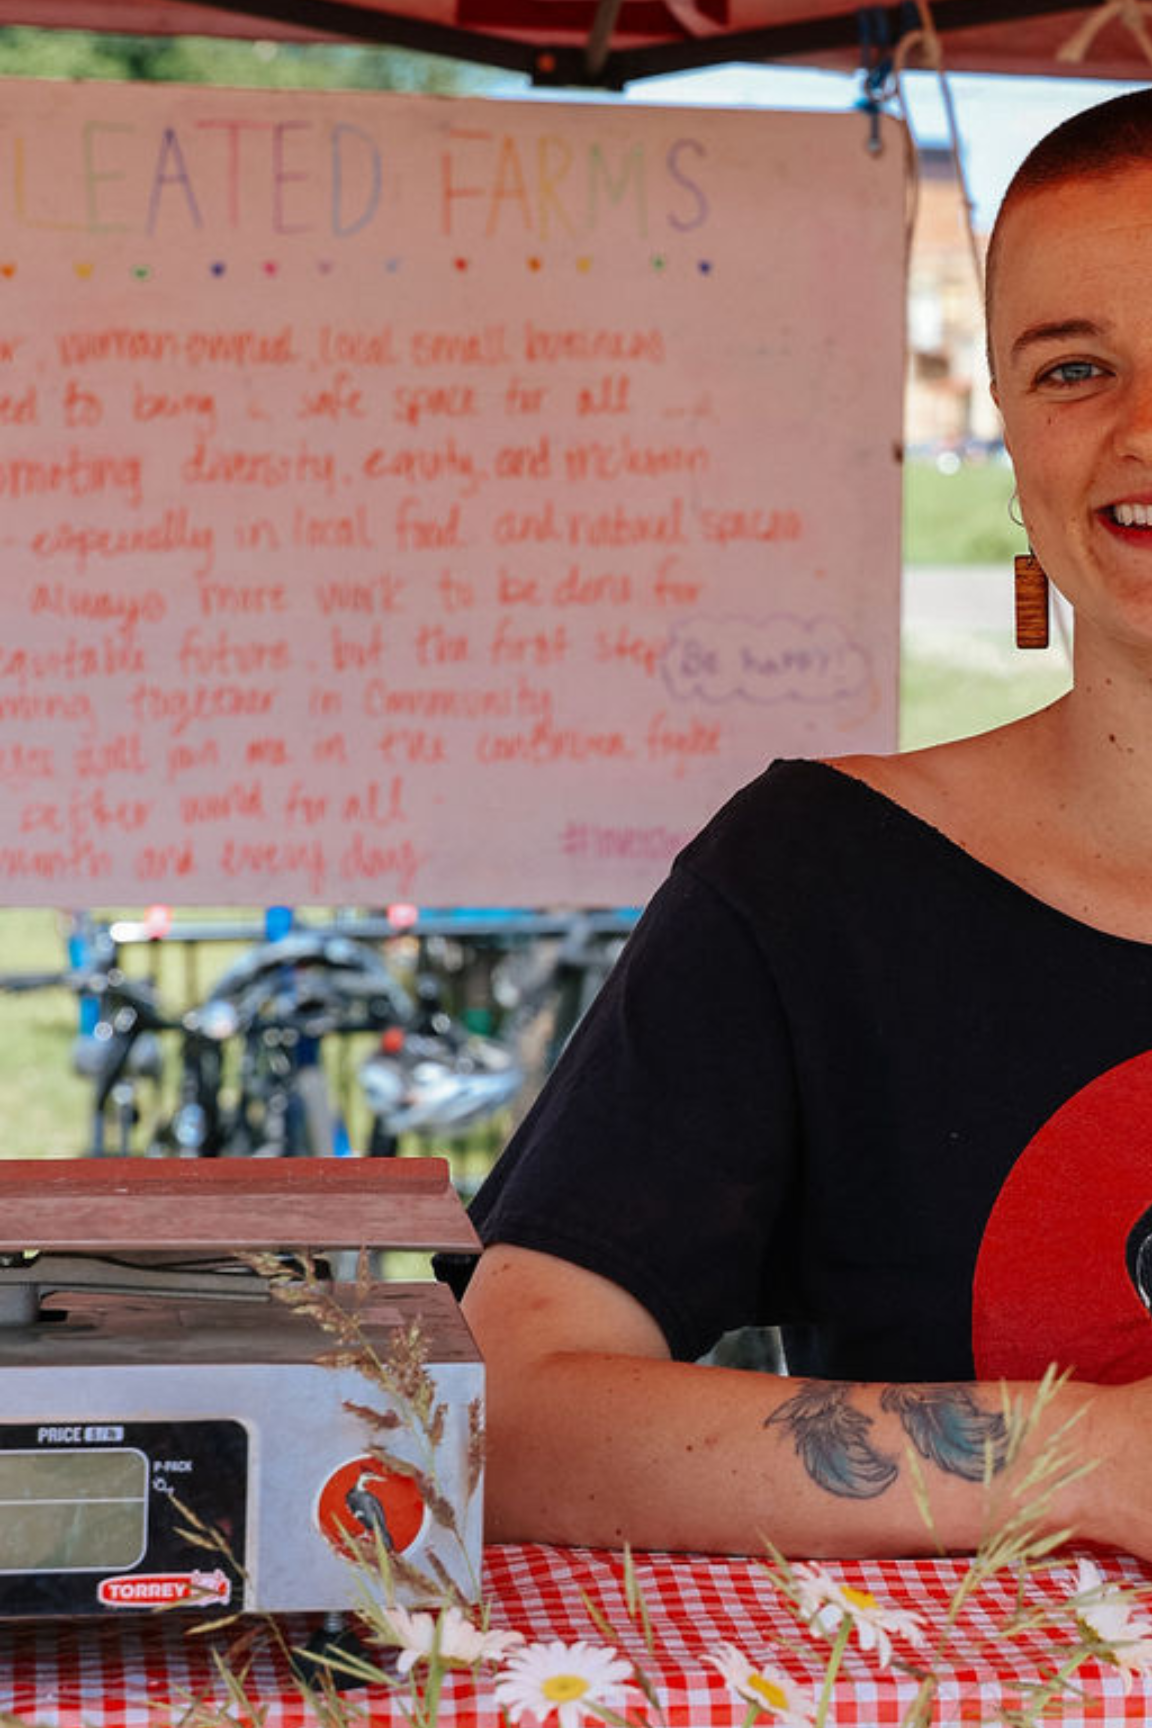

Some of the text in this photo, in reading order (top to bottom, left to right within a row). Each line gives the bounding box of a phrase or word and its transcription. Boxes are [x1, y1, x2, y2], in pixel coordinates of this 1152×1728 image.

[12, 118, 711, 240] LEATED FARMS
[411, 323, 510, 366] small
[523, 319, 666, 366] business
[0, 382, 40, 428] ed
[63, 379, 103, 429] to
[297, 372, 369, 420] safe
[394, 384, 480, 429] space
[503, 376, 550, 416] for
[575, 374, 629, 418] all
[0, 446, 141, 508] moting
[495, 434, 550, 480] and
[563, 433, 710, 482] inclusion
[31, 507, 215, 578] especially
[234, 519, 280, 550] in
[294, 507, 373, 549] local
[394, 497, 468, 551] food
[494, 499, 560, 547] and
[566, 497, 690, 548] natural
[702, 508, 803, 546] spaces
[199, 582, 289, 616] more
[316, 576, 403, 616] work
[438, 568, 475, 614] to
[499, 565, 538, 608] be
[553, 562, 632, 608] done
[653, 553, 703, 608] for
[0, 633, 146, 688] quitable
[331, 624, 384, 672] but
[415, 624, 469, 666] the
[490, 615, 568, 663] first
[596, 625, 660, 677] step
[128, 683, 275, 738] together
[309, 690, 343, 716] in
[246, 737, 294, 766] me
[313, 732, 349, 766] in
[379, 729, 447, 763] the
[181, 779, 266, 826] world
[286, 780, 326, 828] for
[341, 776, 407, 827] all
[134, 838, 196, 880] and
[221, 837, 327, 896] every
[38, 1426, 82, 1443] PRICE
[110, 1582, 186, 1598] TORREY
